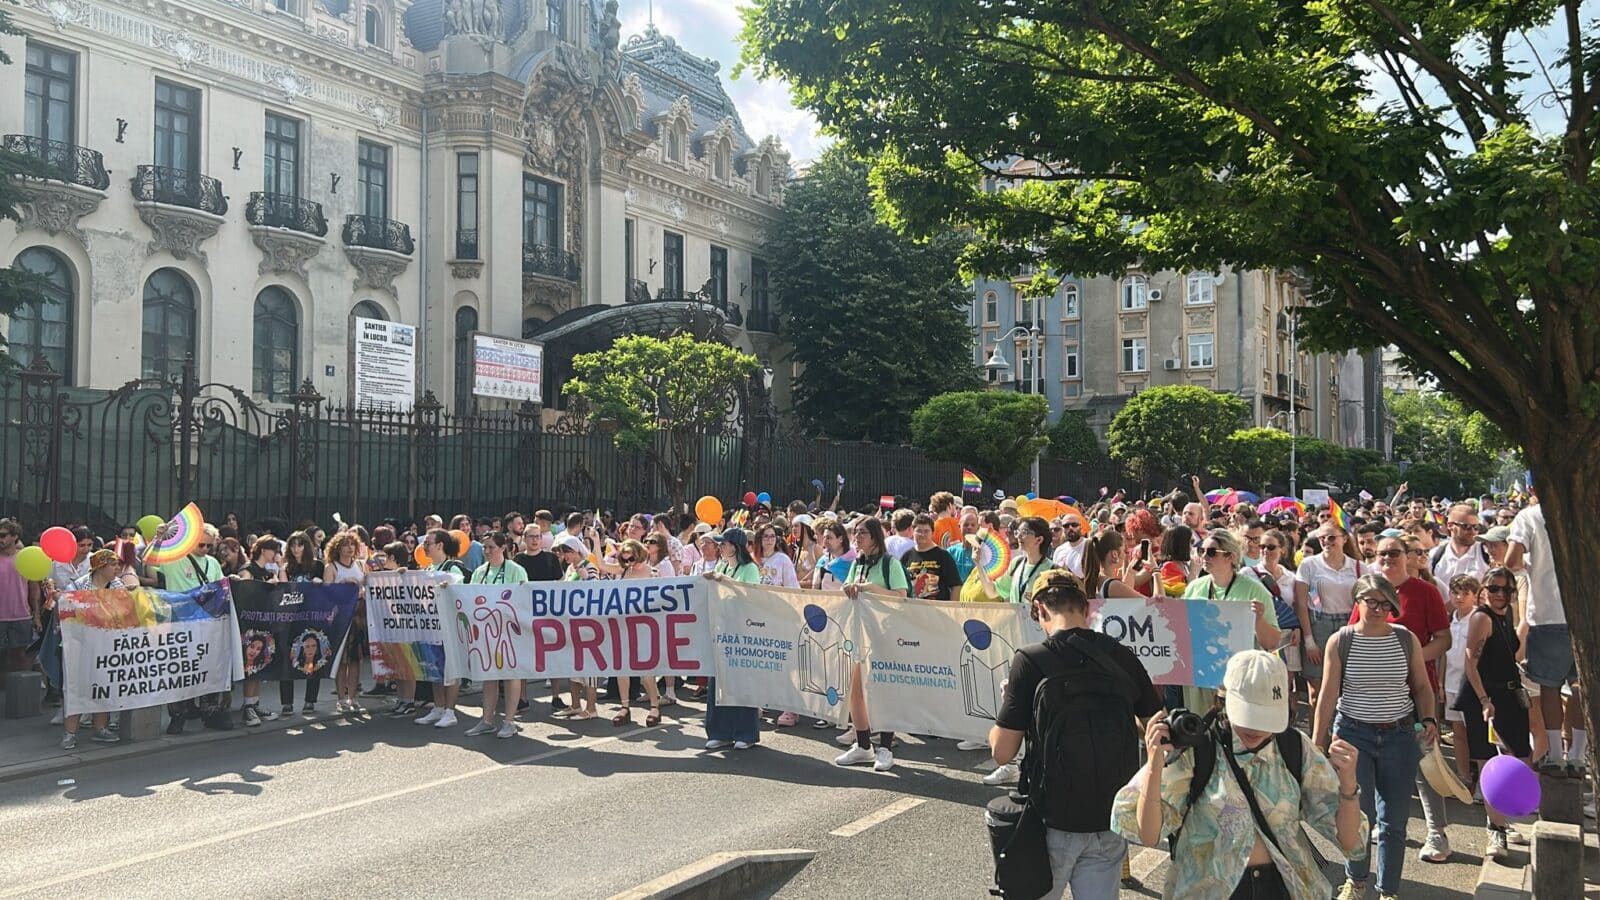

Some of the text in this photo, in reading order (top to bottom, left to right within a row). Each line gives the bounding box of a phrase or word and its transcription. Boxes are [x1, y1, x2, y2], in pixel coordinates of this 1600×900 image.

[369, 586, 435, 600] FRICILE VOAS
[532, 584, 694, 617] BUCHAREST
[391, 604, 426, 615] CENZURA
[421, 619, 431, 630] DE
[432, 619, 441, 630] ST
[1102, 615, 1155, 643] OM
[113, 631, 193, 652] FĂRĂ LEGI
[532, 614, 701, 672] PRIDE
[717, 633, 793, 650] FĂRĂ TRANSFOBIE
[96, 643, 209, 669] HOMOFOBE ȘI
[734, 648, 787, 661] HOMOFOBIE
[107, 659, 200, 683] TRANSFOBE
[873, 674, 887, 683] NU
[92, 671, 209, 699] ÎN PARLAMENT
